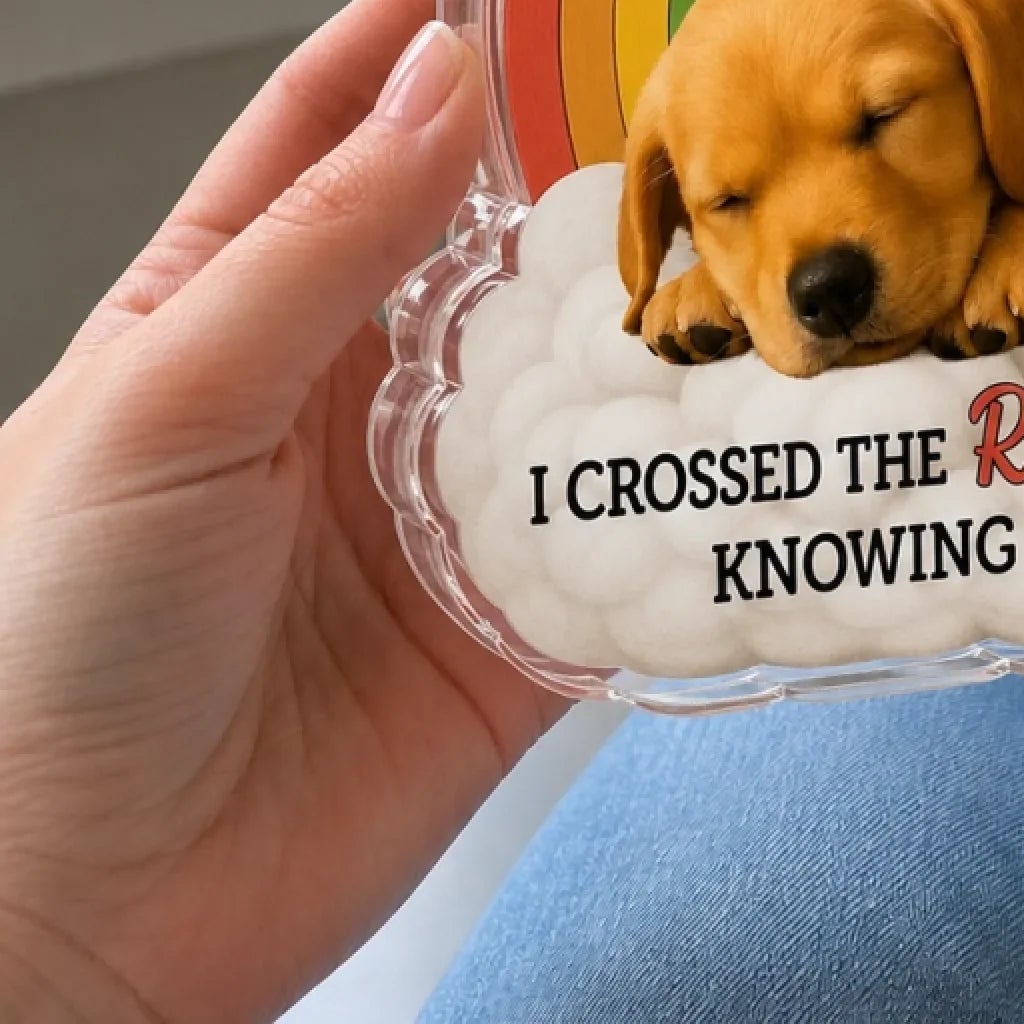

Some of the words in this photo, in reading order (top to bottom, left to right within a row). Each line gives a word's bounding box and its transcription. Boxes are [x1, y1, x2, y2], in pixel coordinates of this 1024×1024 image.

[529, 465, 549, 525] I
[567, 441, 821, 521] CROSSED
[837, 427, 947, 493] THE
[711, 515, 1017, 603] KNOWING
